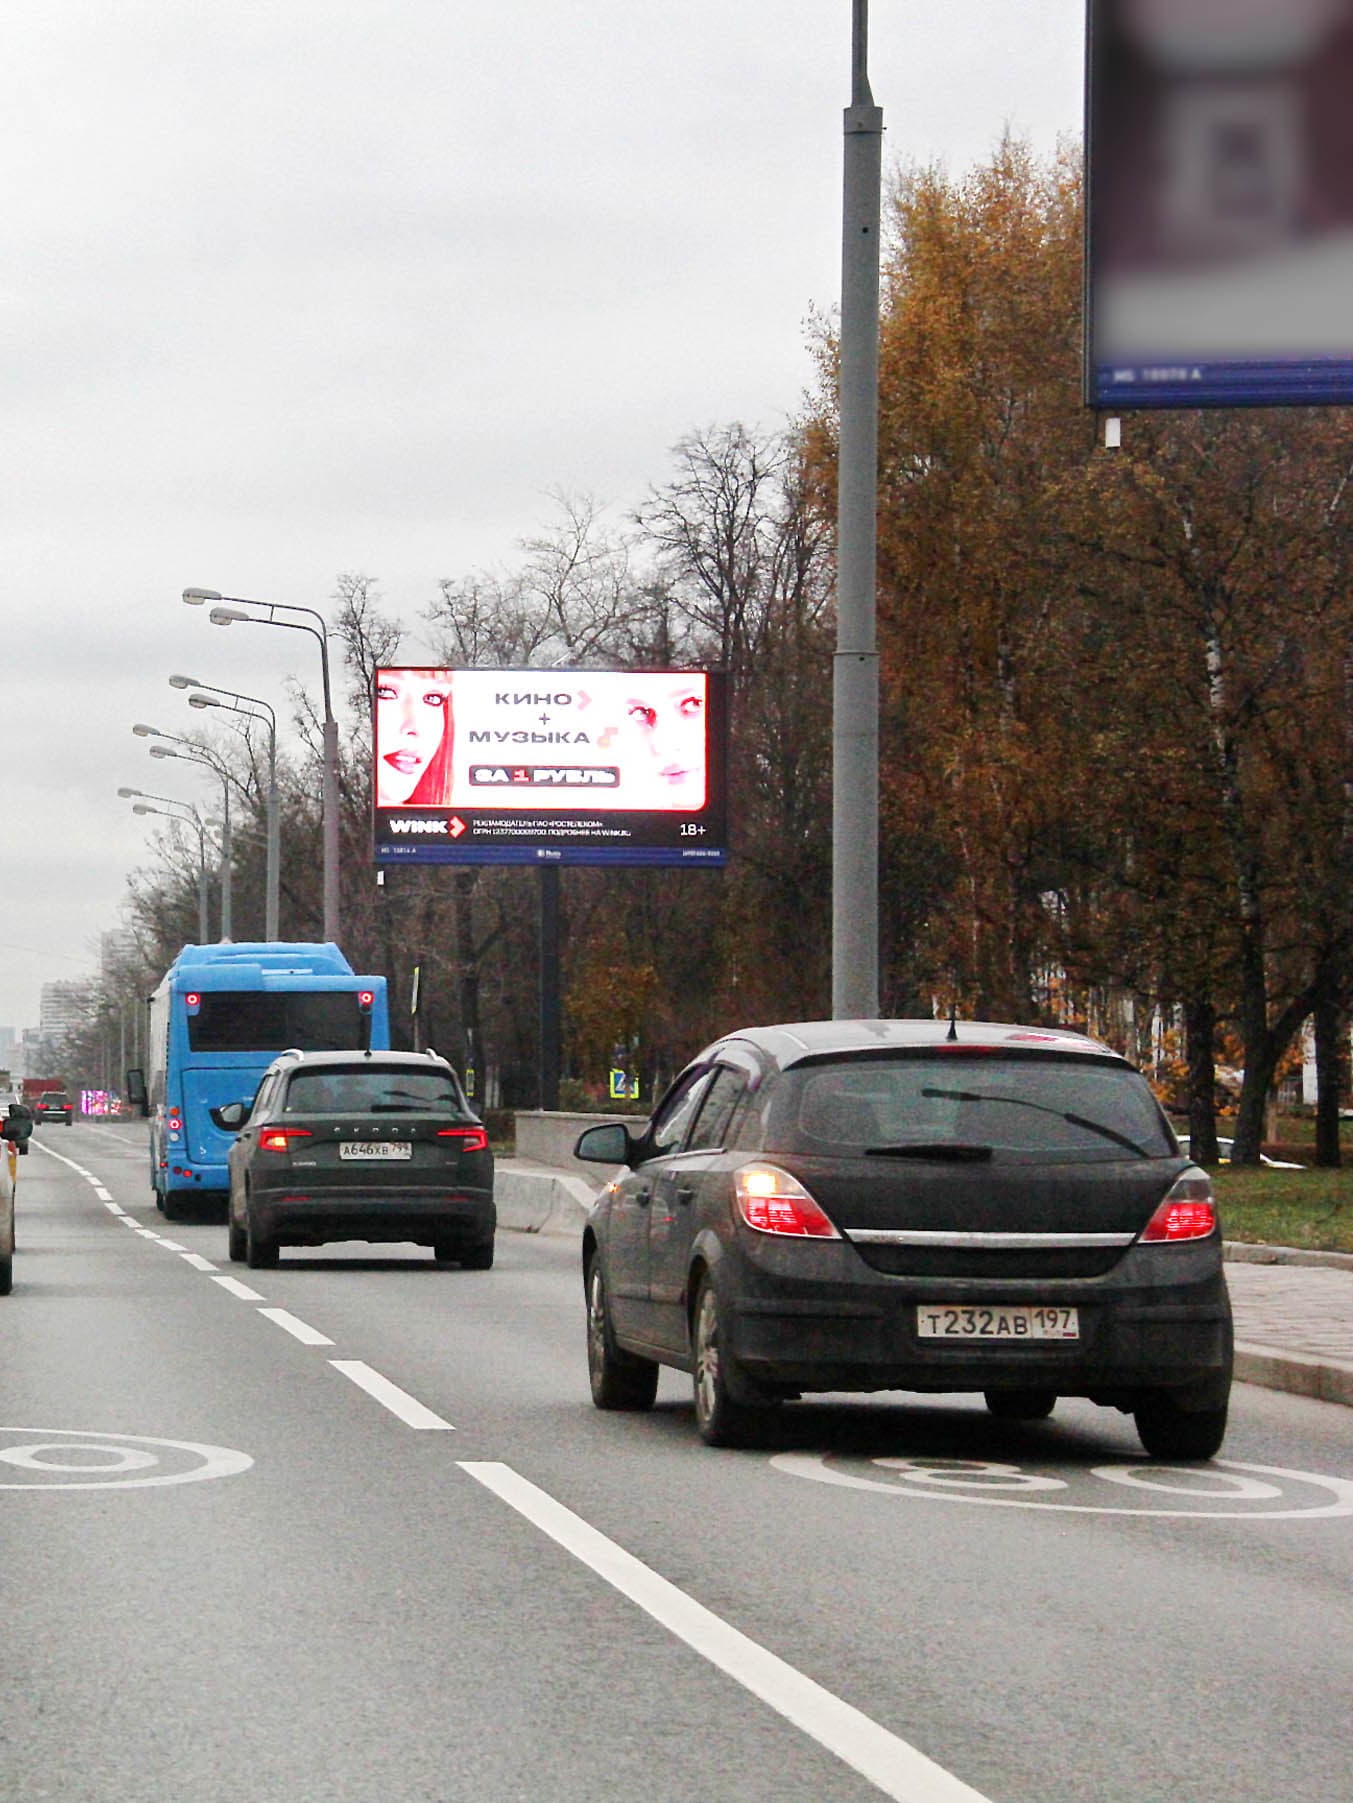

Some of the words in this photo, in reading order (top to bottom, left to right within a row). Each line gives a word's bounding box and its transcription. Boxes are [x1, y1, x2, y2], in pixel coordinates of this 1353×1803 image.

[495, 693, 572, 705] КИНО
[469, 731, 590, 744] МУЗЫКА
[513, 769, 530, 783] 1
[533, 769, 616, 784] РУБЛЬ
[390, 819, 449, 834] WINK
[680, 823, 707, 836] 18+
[927, 1310, 1028, 1335] Т232АВ
[1034, 1309, 1071, 1329] 197
[870, 1456, 1284, 1499] 80
